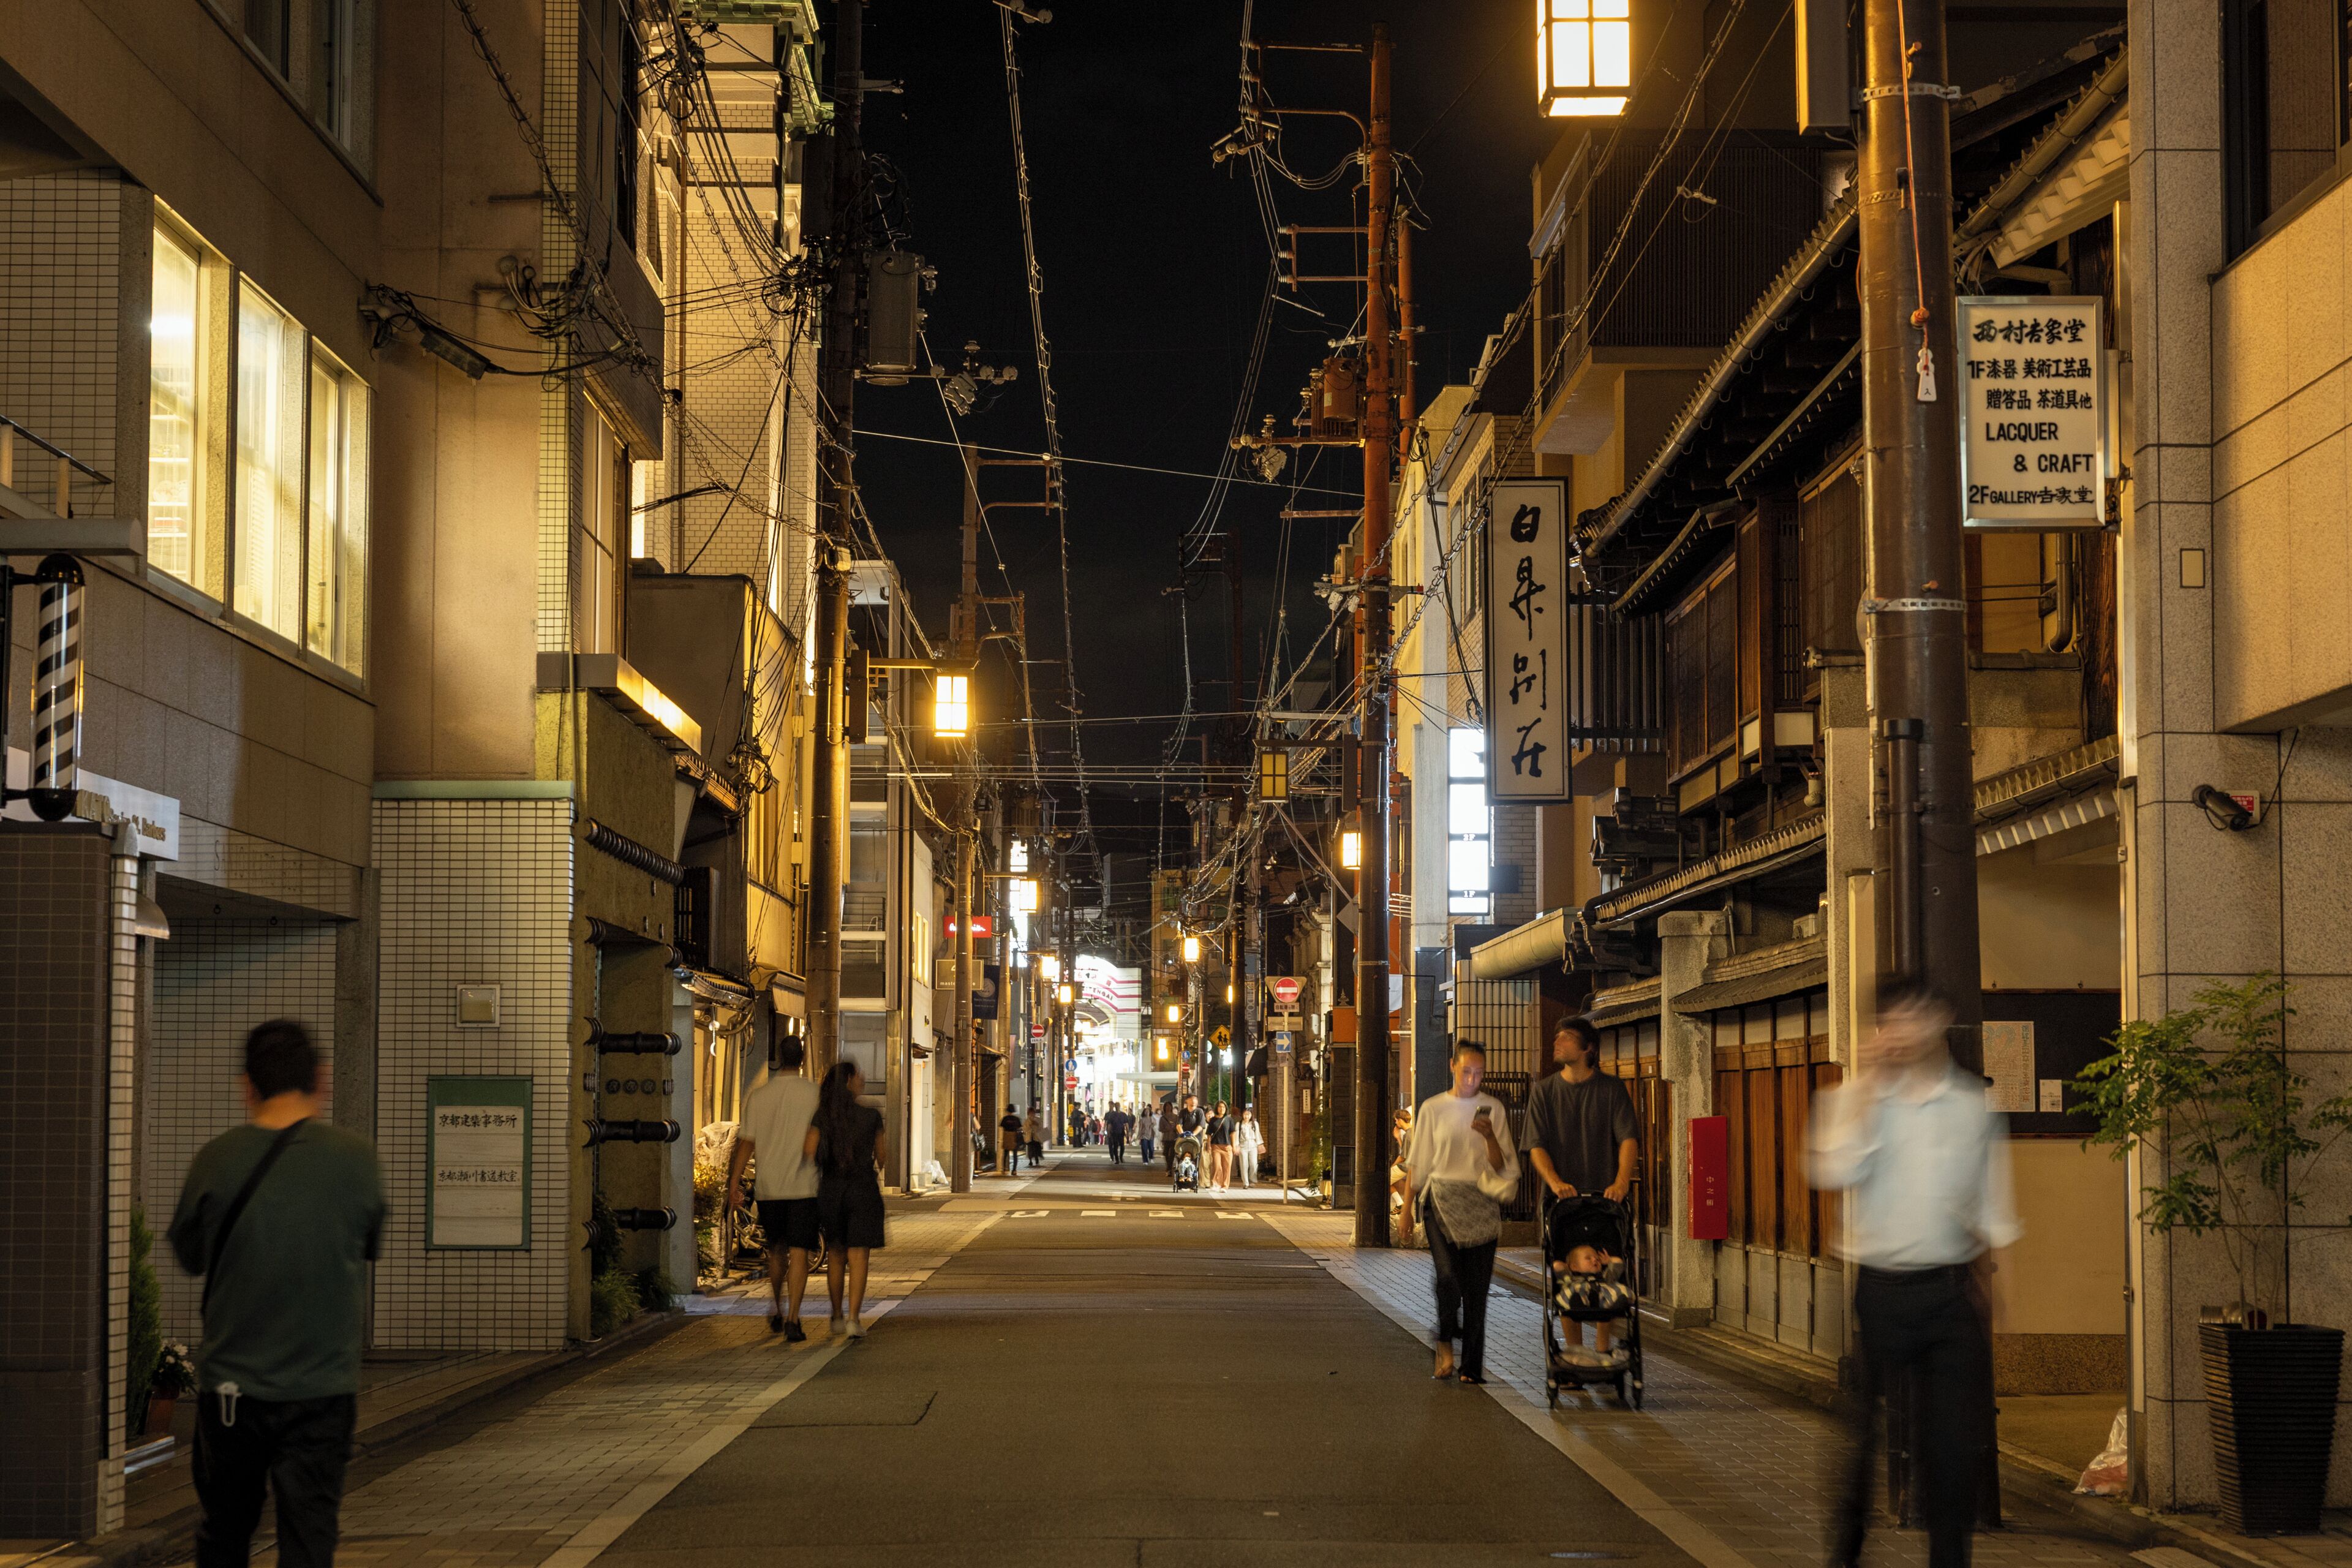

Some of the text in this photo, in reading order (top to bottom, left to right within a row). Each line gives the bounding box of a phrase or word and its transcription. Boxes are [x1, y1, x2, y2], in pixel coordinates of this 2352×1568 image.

[2022, 358, 2092, 379] 美術工芸品
[1986, 390, 2092, 410] 贈答品 茶道具他
[1986, 422, 2059, 442] LACQUER
[2013, 454, 2094, 473] & CRAFT
[141, 817, 166, 842] Barbers
[439, 1114, 518, 1128] 京都建築事務所
